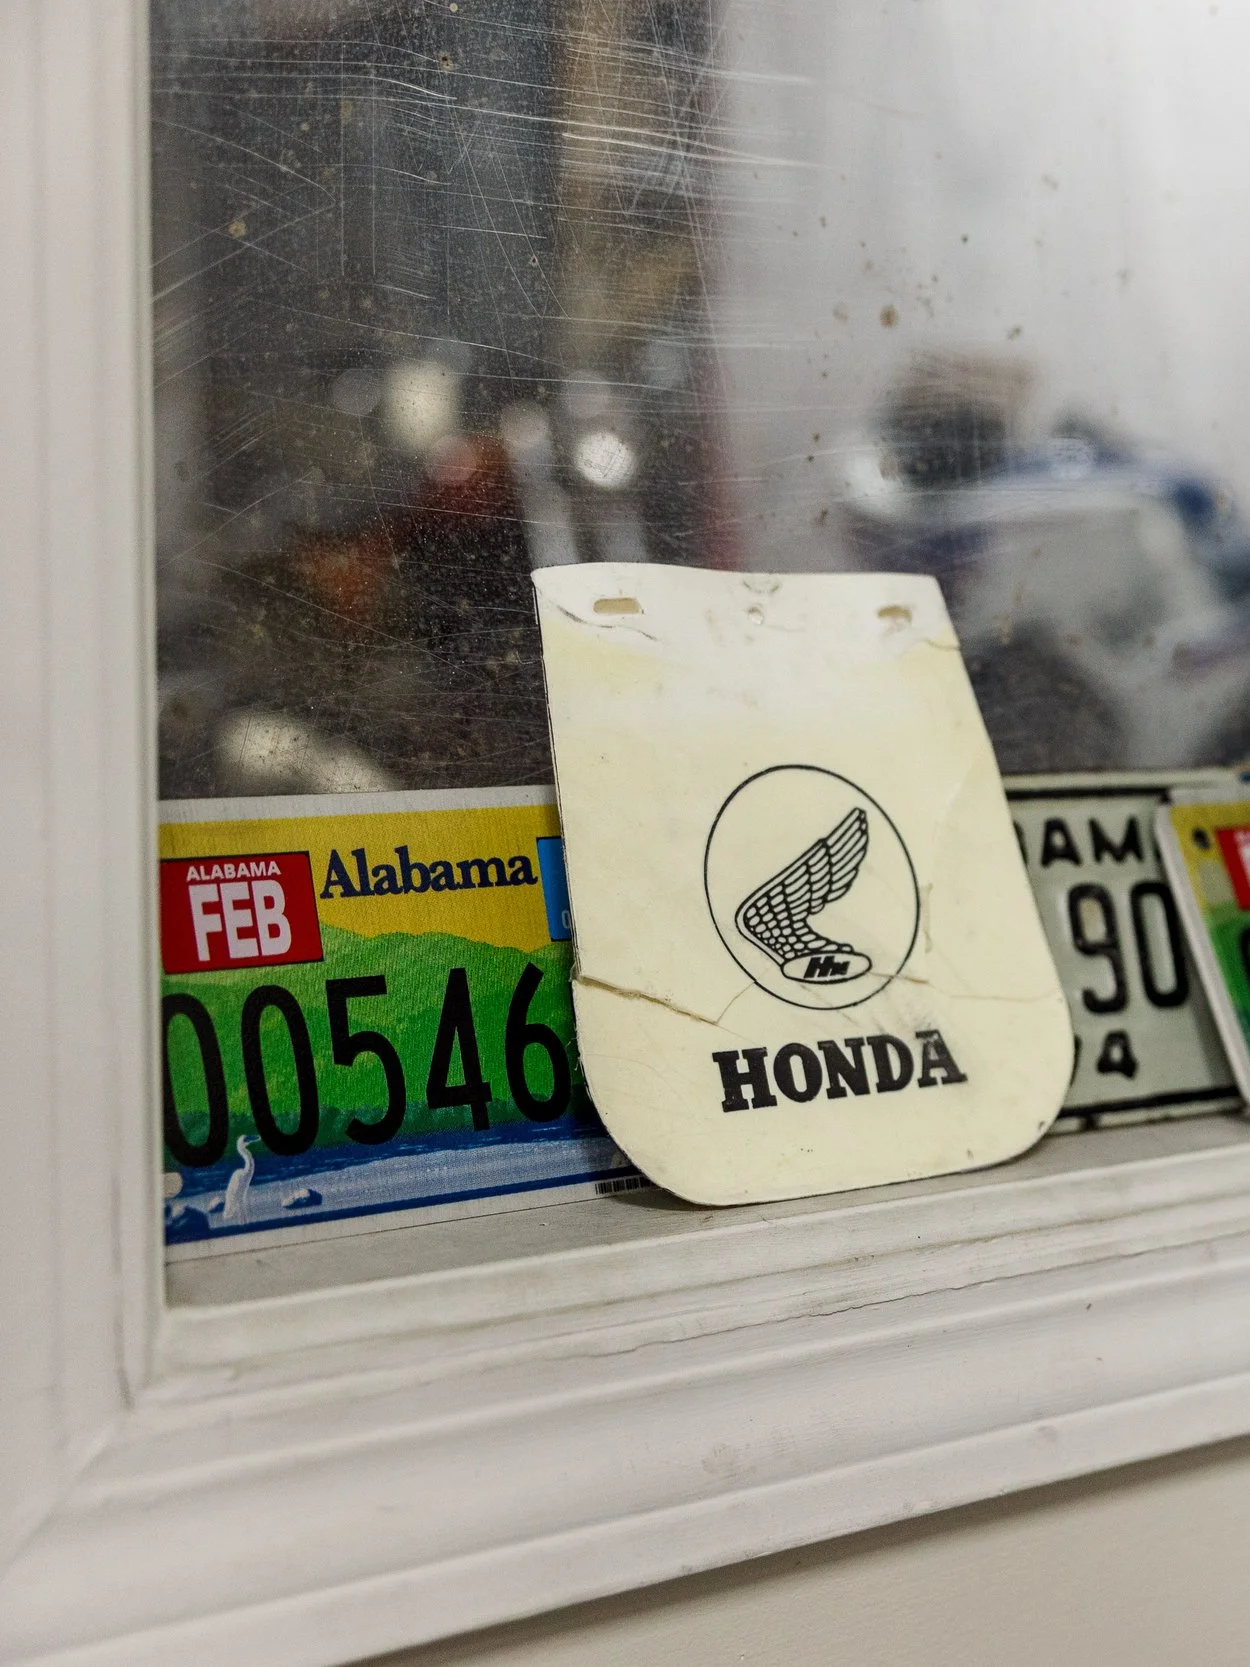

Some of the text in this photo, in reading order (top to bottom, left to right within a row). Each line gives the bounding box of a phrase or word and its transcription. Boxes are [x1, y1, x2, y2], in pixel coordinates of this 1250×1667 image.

[186, 860, 281, 882] ALABAMA
[320, 845, 538, 899] Alabama
[188, 880, 292, 962] FEB
[712, 1029, 969, 1113] HONDA
